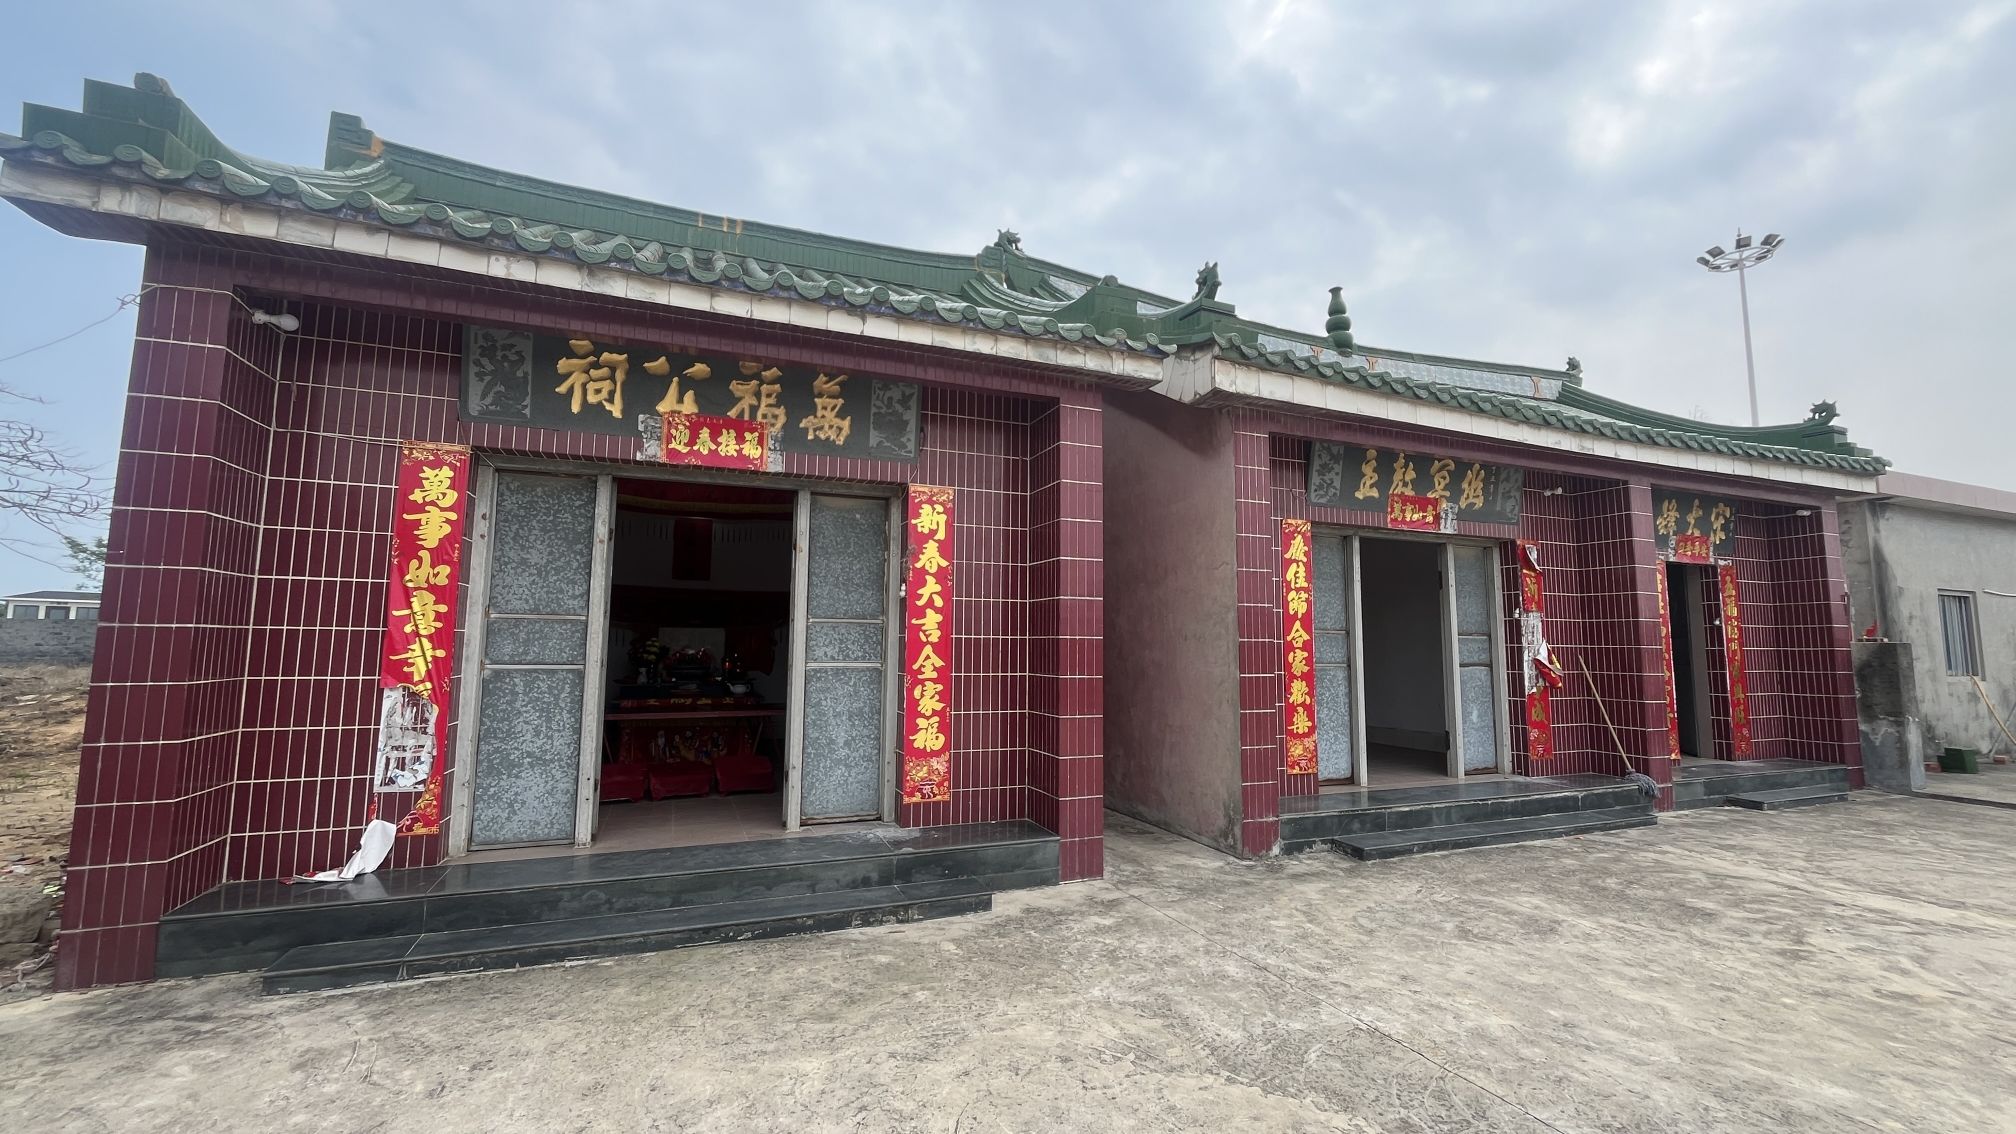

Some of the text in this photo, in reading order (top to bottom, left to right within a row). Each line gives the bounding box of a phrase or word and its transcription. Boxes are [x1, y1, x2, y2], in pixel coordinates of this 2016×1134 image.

[668, 427, 763, 460] 迎春接福
[389, 465, 459, 700] 萬事如意幸
[910, 503, 951, 752] 新春大吉全家福
